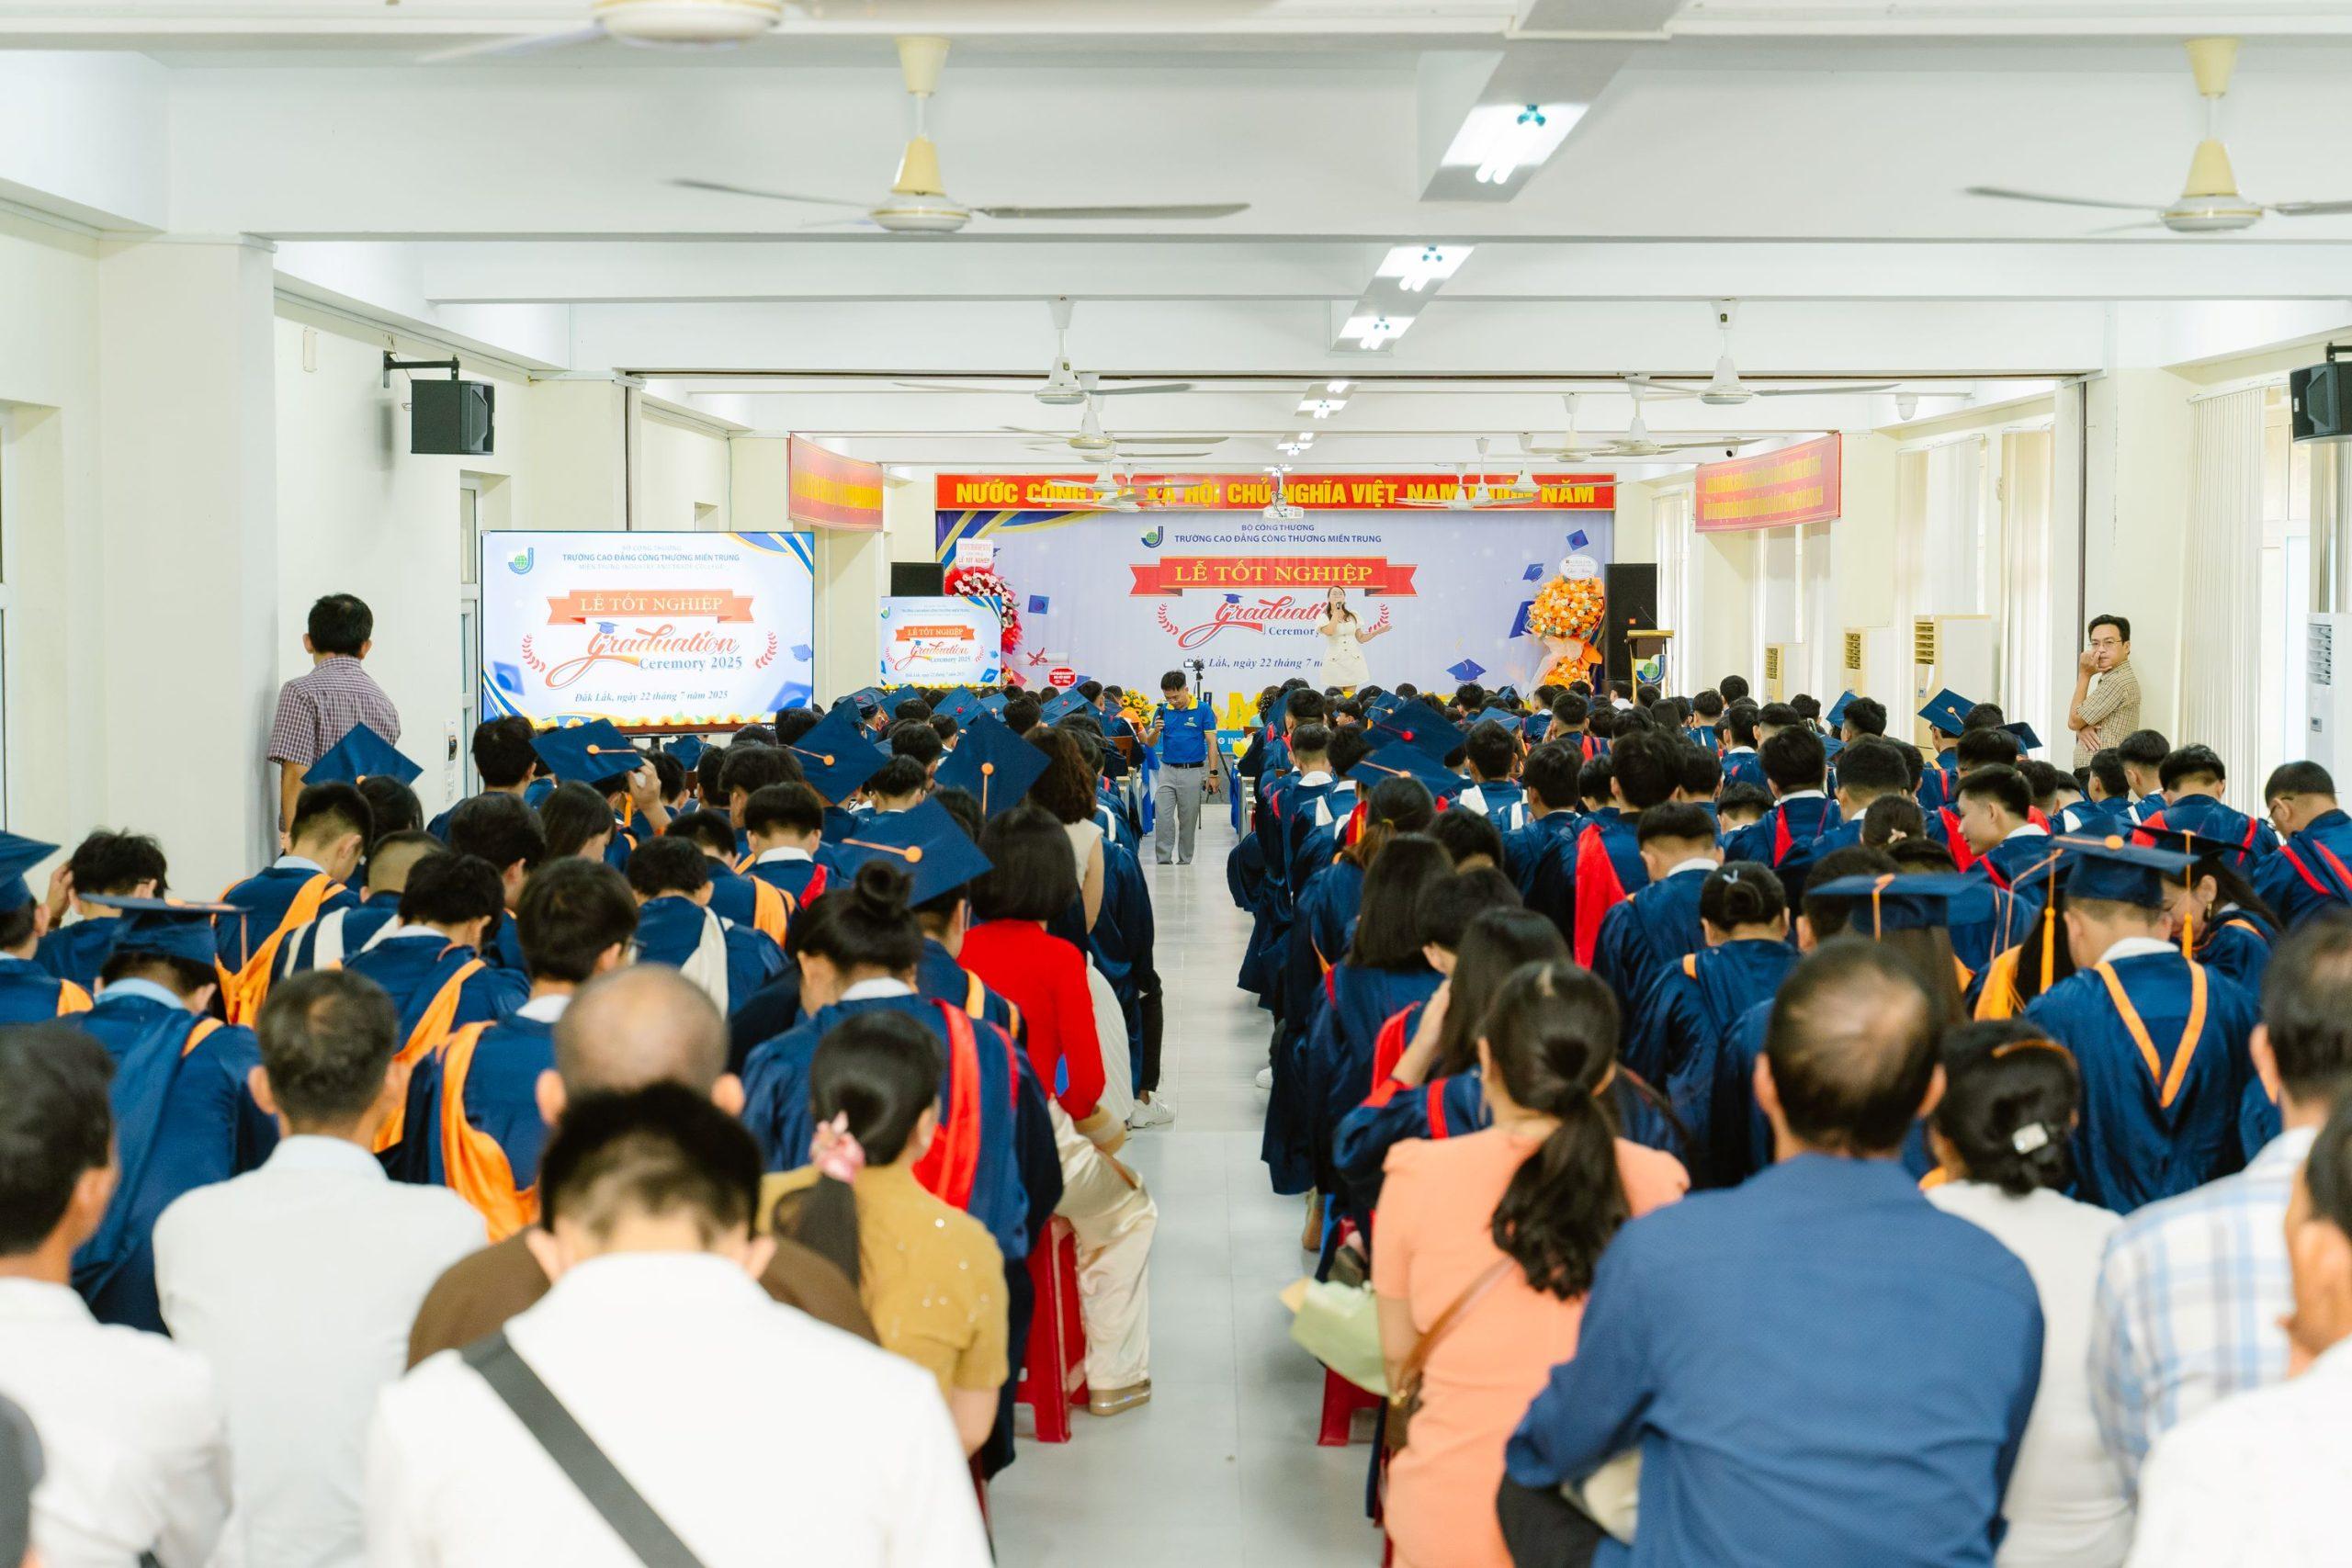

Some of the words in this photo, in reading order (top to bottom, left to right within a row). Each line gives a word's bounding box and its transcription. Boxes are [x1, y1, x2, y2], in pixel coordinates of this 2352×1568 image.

[956, 479, 1018, 503] NƯỚC
[1184, 478, 1220, 507] HỘI
[1227, 477, 1271, 503] CHỦ
[1283, 479, 1347, 503] NGHĨA
[1351, 479, 1398, 507] VIỆT
[1407, 483, 1459, 503] NAM
[1541, 479, 1595, 503] NĂM
[1214, 535, 1232, 543] CAO
[1351, 535, 1382, 543] TRUNG
[596, 553, 613, 561] CAO
[714, 553, 740, 561] TRUNG
[1174, 560, 1208, 581] LỄ
[1215, 559, 1268, 581] TỐT
[1273, 563, 1374, 584] NGHIỆP
[580, 592, 605, 612] LỄ
[607, 592, 648, 611] TỐT
[652, 595, 723, 613] NGHIỆP
[711, 656, 743, 669] 2025
[1233, 658, 1257, 669] ngày
[1260, 658, 1272, 667] 22
[1274, 658, 1302, 669] tháng
[1306, 658, 1312, 667] 7
[639, 693, 651, 701] 22
[707, 690, 729, 699] 2025
